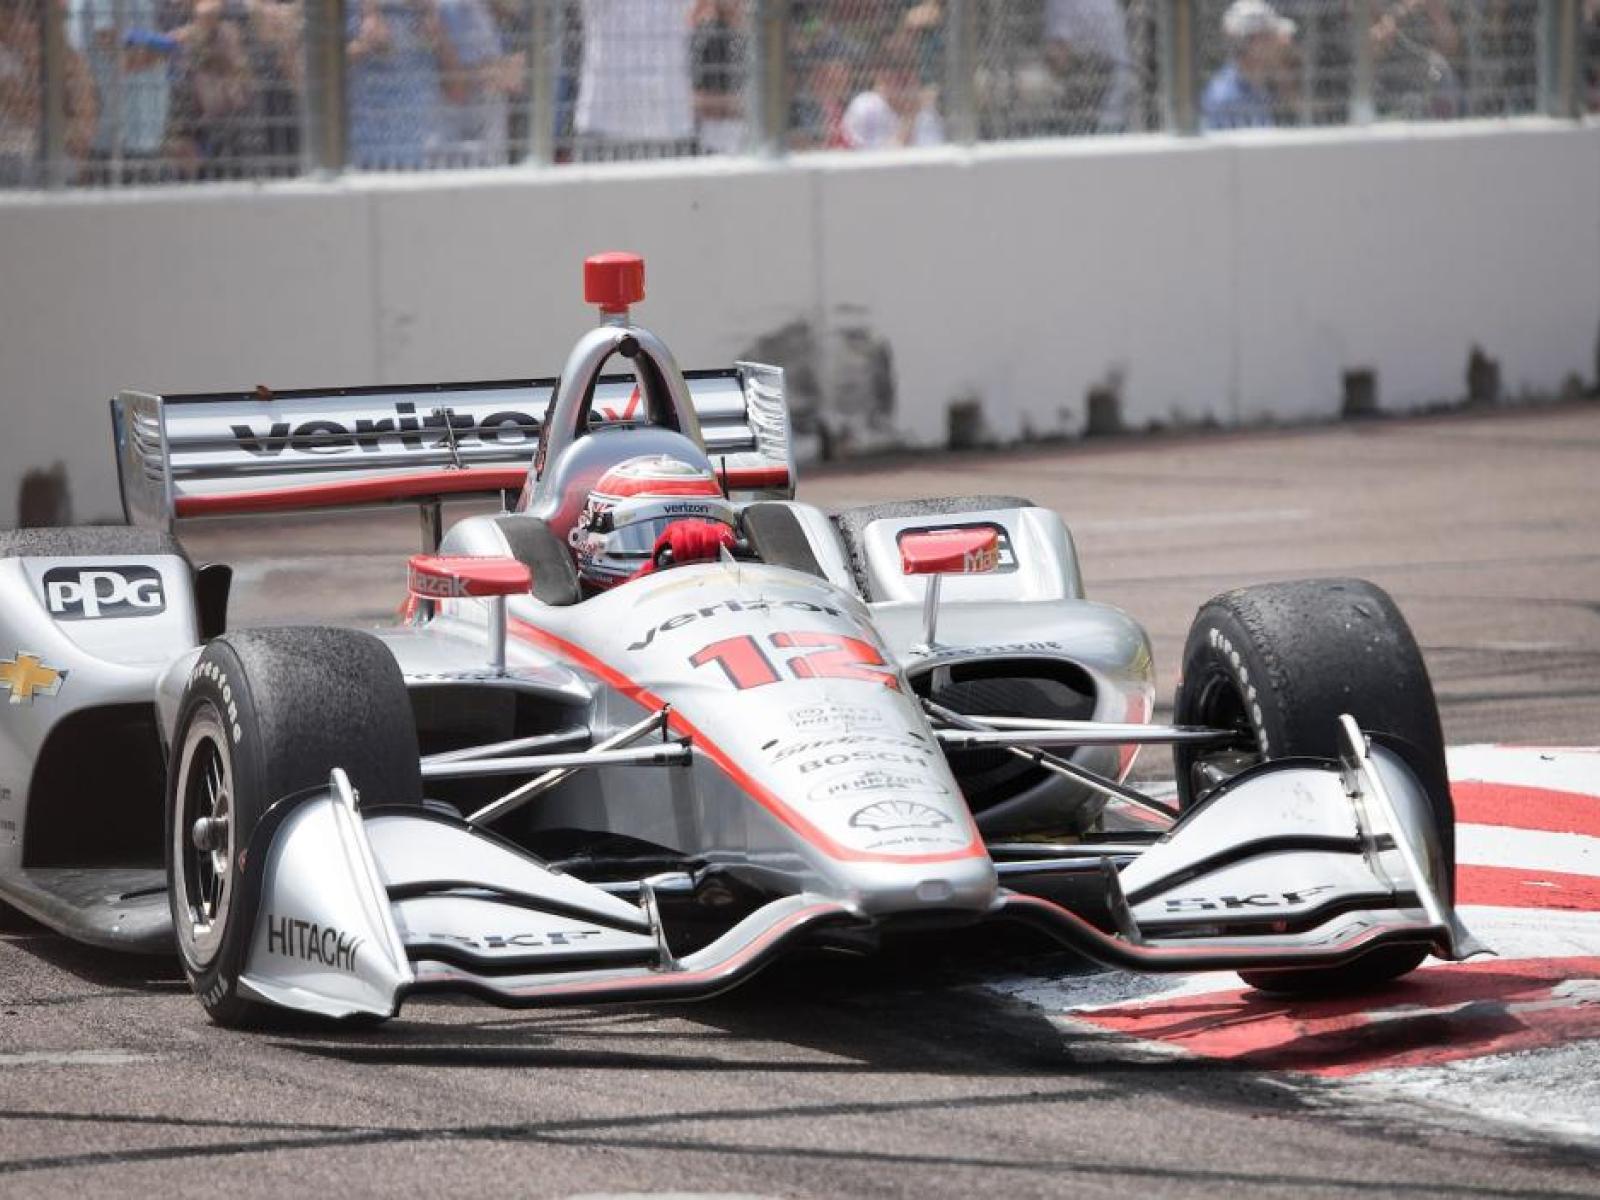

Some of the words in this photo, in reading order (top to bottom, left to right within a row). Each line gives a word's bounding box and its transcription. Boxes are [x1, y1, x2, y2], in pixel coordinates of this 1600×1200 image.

[230, 402, 603, 457] verizo
[663, 502, 709, 514] verizon
[48, 571, 163, 617] PPG
[688, 630, 899, 690] 12
[798, 750, 928, 773] BOSCH
[1166, 885, 1336, 912] SKF
[267, 914, 366, 971] HITACHI
[429, 931, 601, 948] SKF
